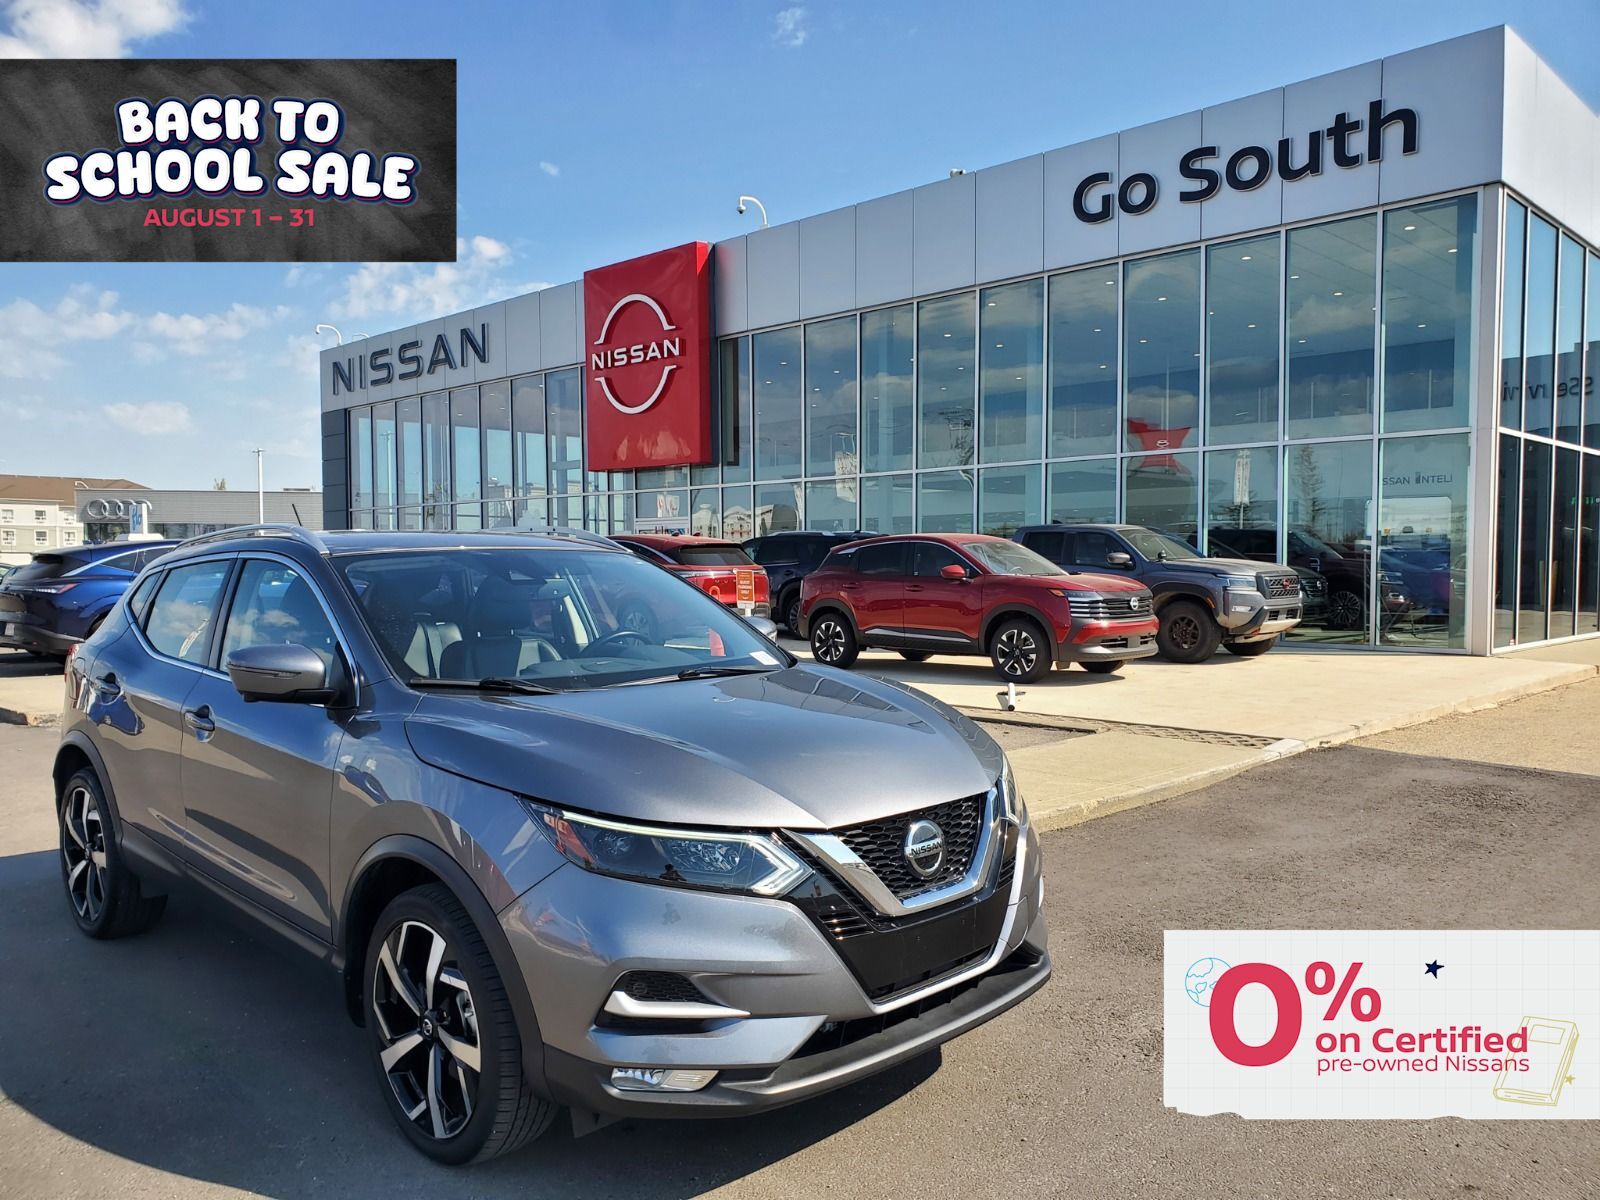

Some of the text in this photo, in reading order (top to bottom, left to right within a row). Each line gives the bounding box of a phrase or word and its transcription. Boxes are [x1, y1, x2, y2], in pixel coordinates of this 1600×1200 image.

[1072, 98, 1420, 224] Go South
[332, 323, 490, 396] NISSAN
[591, 337, 681, 370] NISSAN
[1382, 476, 1410, 486] SSAN
[911, 842, 942, 856] NISSAN
